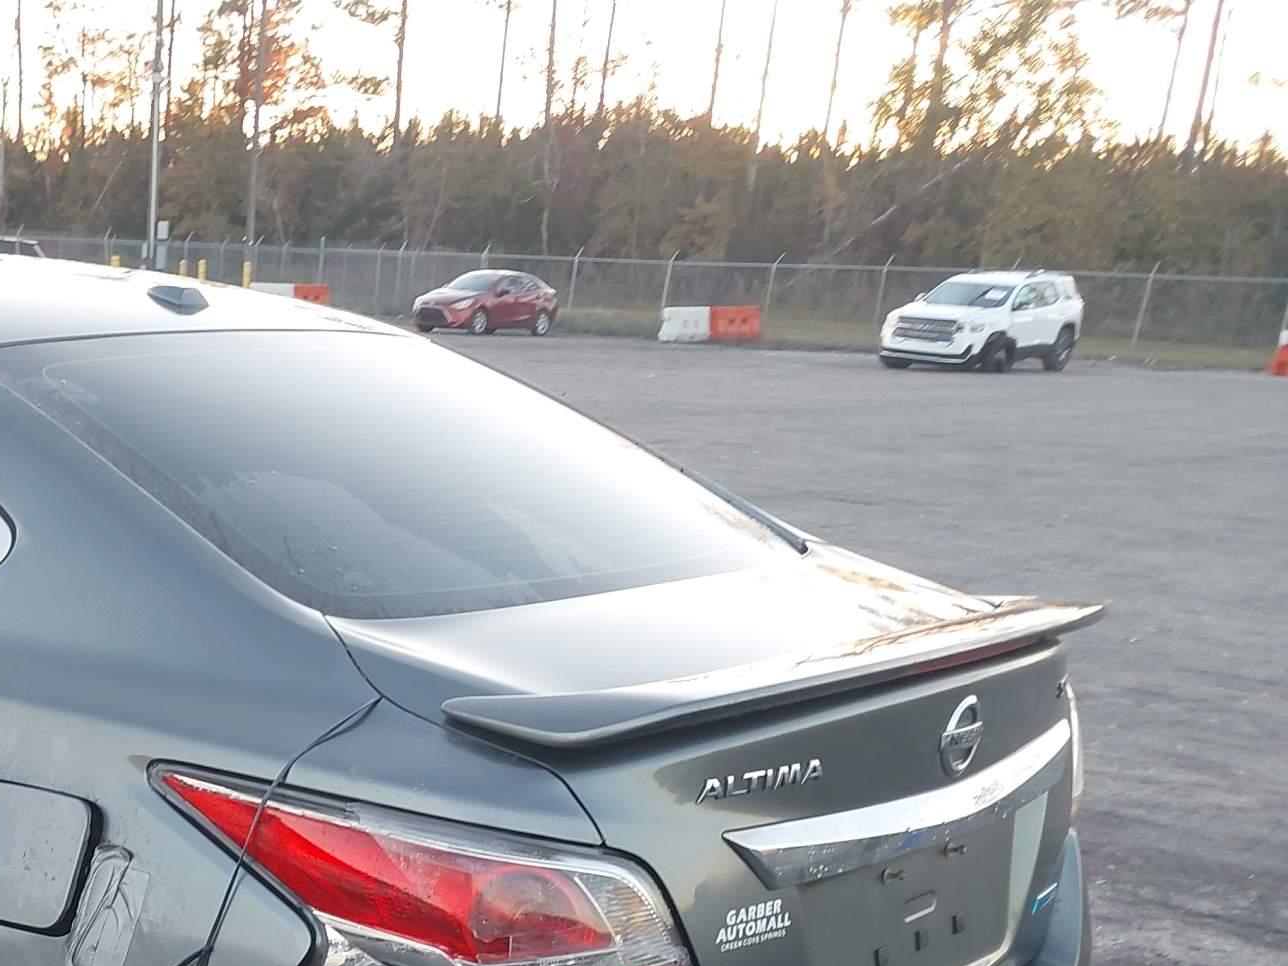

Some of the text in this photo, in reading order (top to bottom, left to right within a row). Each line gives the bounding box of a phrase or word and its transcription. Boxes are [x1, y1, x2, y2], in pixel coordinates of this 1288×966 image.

[695, 759, 823, 805] ALTIMA
[715, 911, 792, 945] AUTOMALL
[726, 898, 782, 926] GARBER
